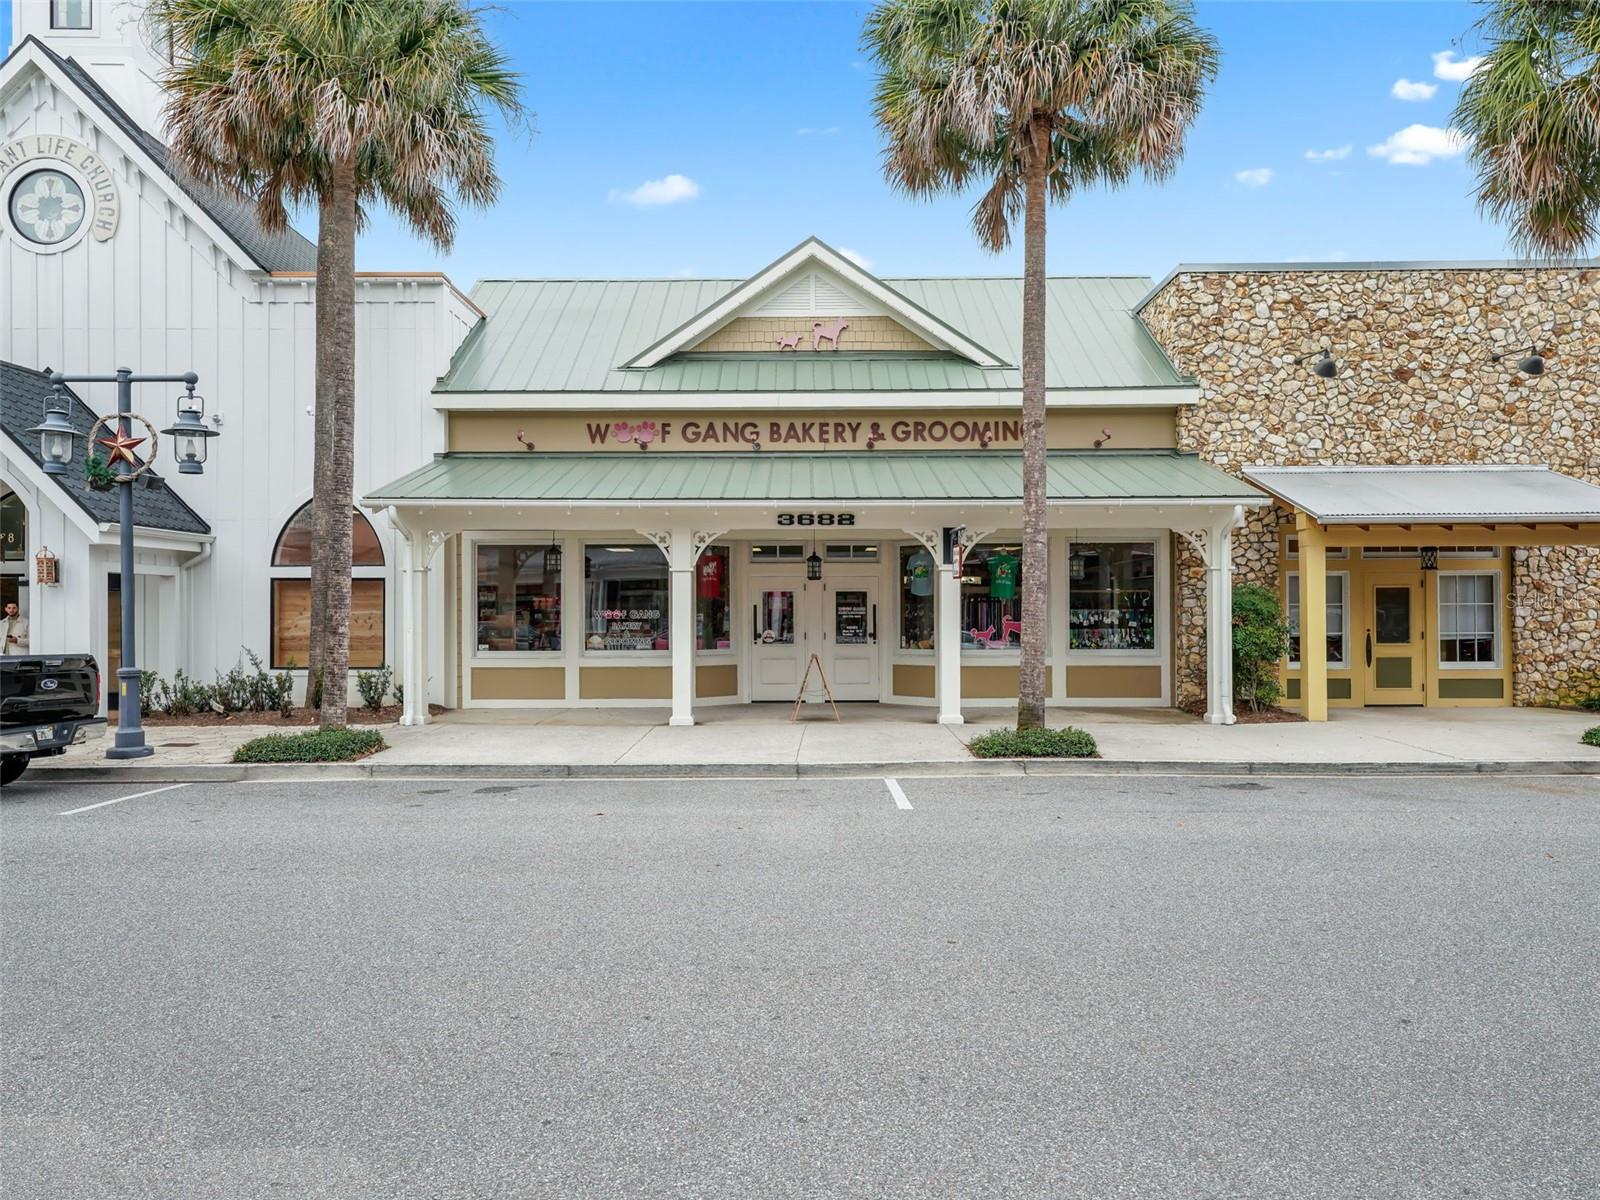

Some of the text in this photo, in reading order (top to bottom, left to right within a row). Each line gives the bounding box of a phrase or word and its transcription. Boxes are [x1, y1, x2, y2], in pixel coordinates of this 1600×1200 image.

[37, 137, 78, 160] LIFE
[79, 155, 115, 231] CHURCH
[681, 421, 760, 444] GANG
[769, 421, 862, 443] BAKERY
[868, 422, 887, 443] &
[891, 420, 1024, 442] GROOMIN
